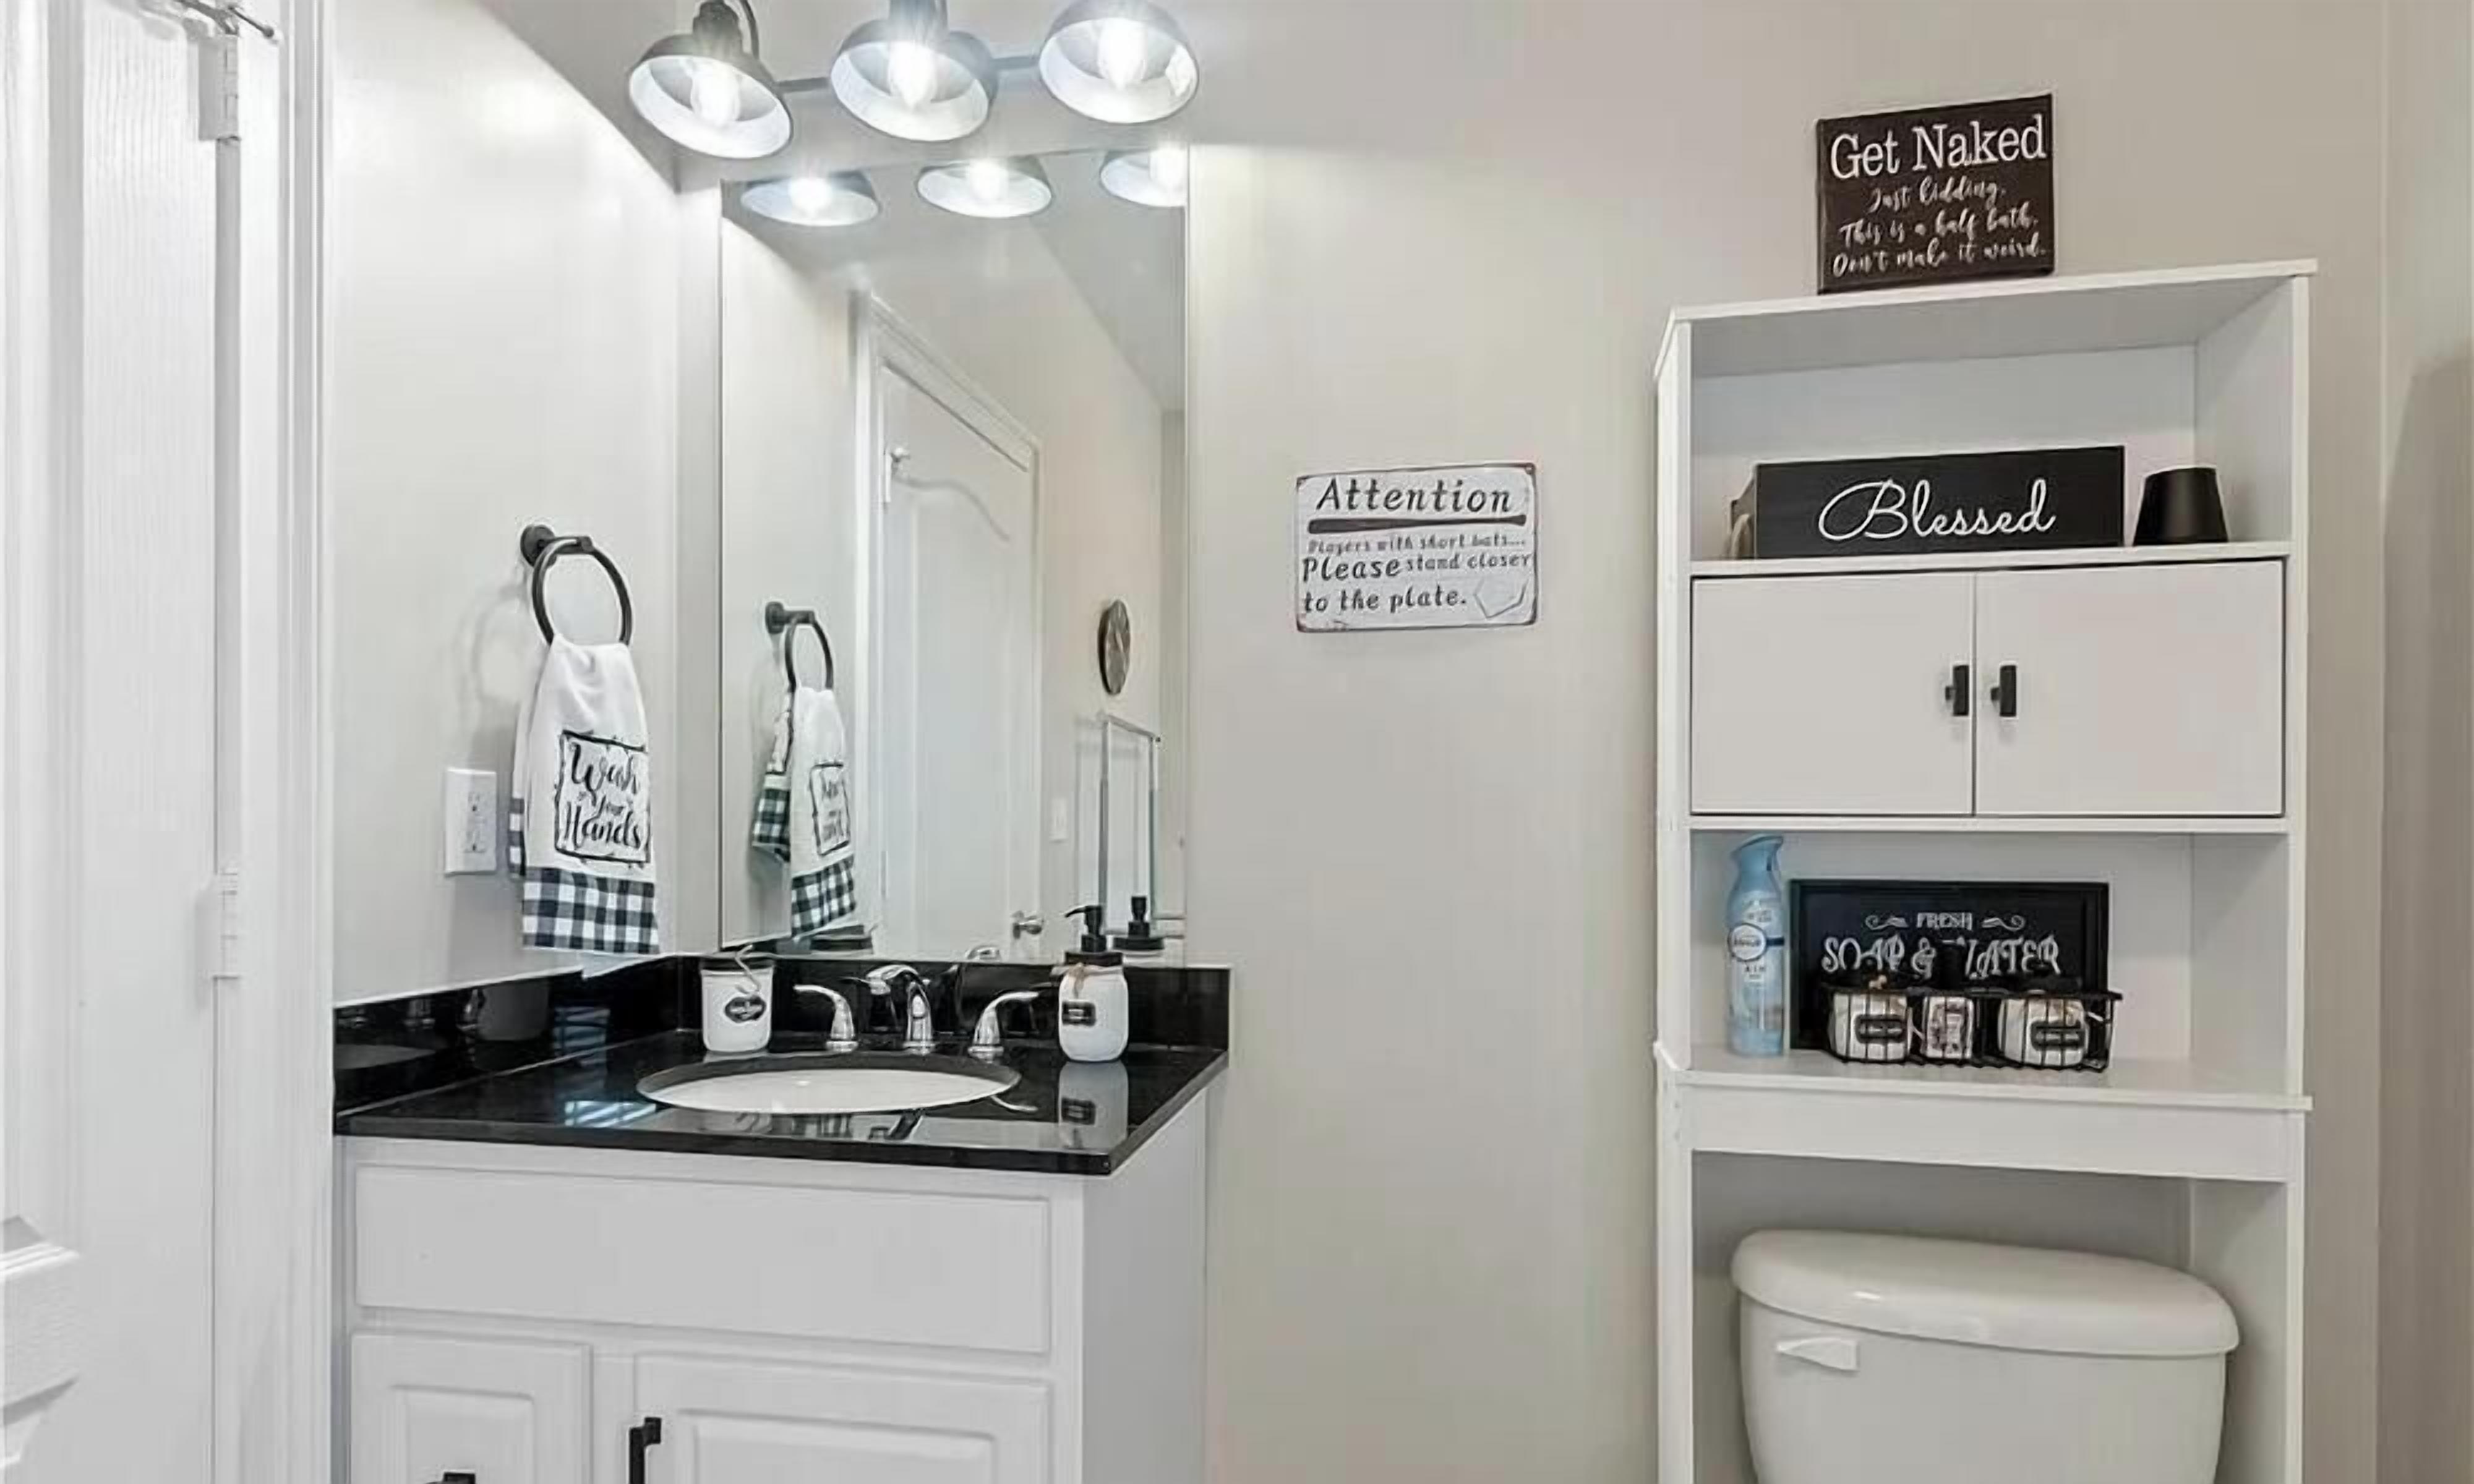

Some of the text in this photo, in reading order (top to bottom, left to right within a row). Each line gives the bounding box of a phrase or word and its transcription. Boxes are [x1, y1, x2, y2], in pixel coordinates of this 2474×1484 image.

[1830, 114, 2047, 179] Get Naked
[1868, 186, 1911, 213] Just
[1839, 218, 1881, 247] This
[1890, 220, 1905, 243] is
[1915, 223, 1927, 236] a
[1935, 208, 1977, 241] half
[1897, 237, 1948, 268] make
[1958, 243, 1978, 263] it
[1316, 478, 1511, 512] Attention
[1818, 478, 2057, 540] Blessed
[1302, 553, 1531, 582] Please stand closer
[1305, 584, 1466, 613] to the plate.
[1917, 913, 1972, 930] FRESH
[1821, 934, 1905, 972] SOAP
[1911, 937, 1936, 979] &
